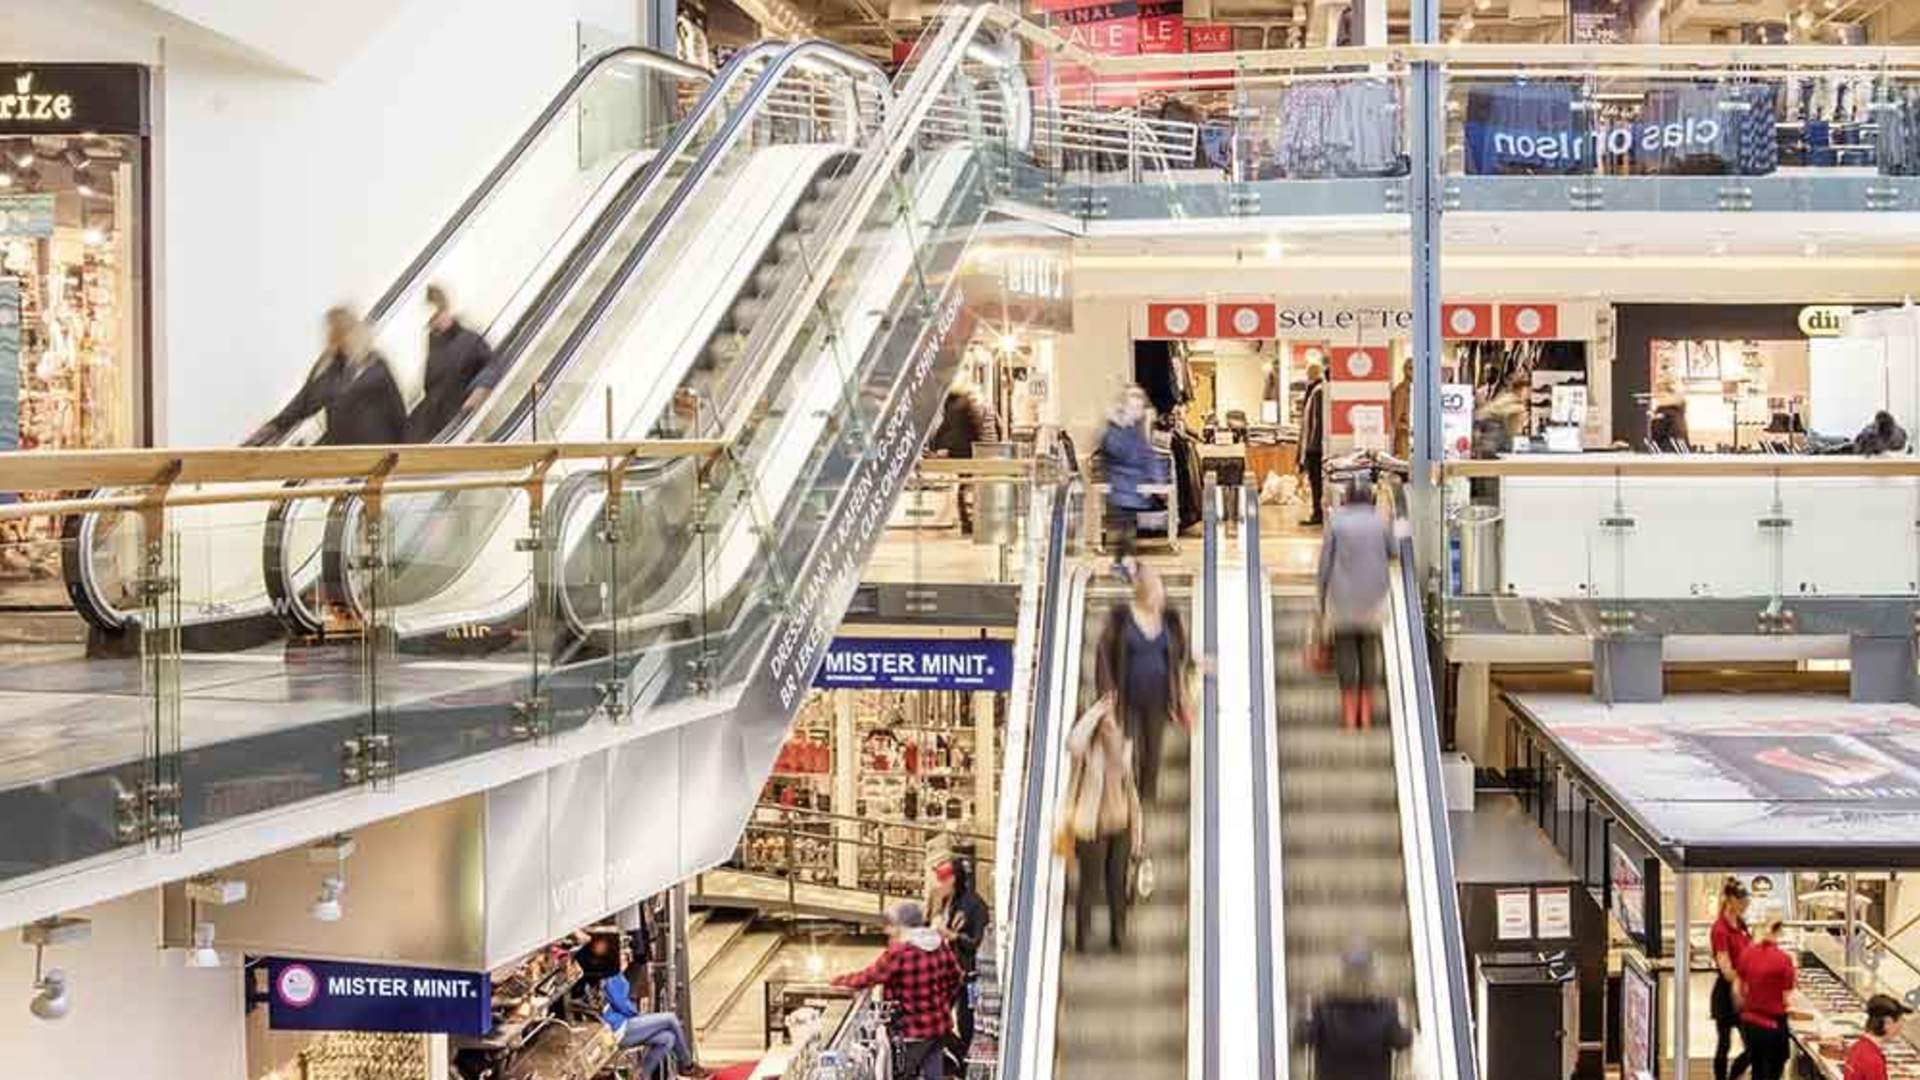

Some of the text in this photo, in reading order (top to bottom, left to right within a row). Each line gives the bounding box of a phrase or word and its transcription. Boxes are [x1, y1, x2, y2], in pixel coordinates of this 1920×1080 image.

[1143, 20, 1173, 41] LE
[1194, 31, 1226, 43] SALE
[0, 94, 72, 119] rize
[826, 652, 915, 674] MISTER
[780, 674, 798, 710] BR
[328, 977, 408, 997] MISTER
